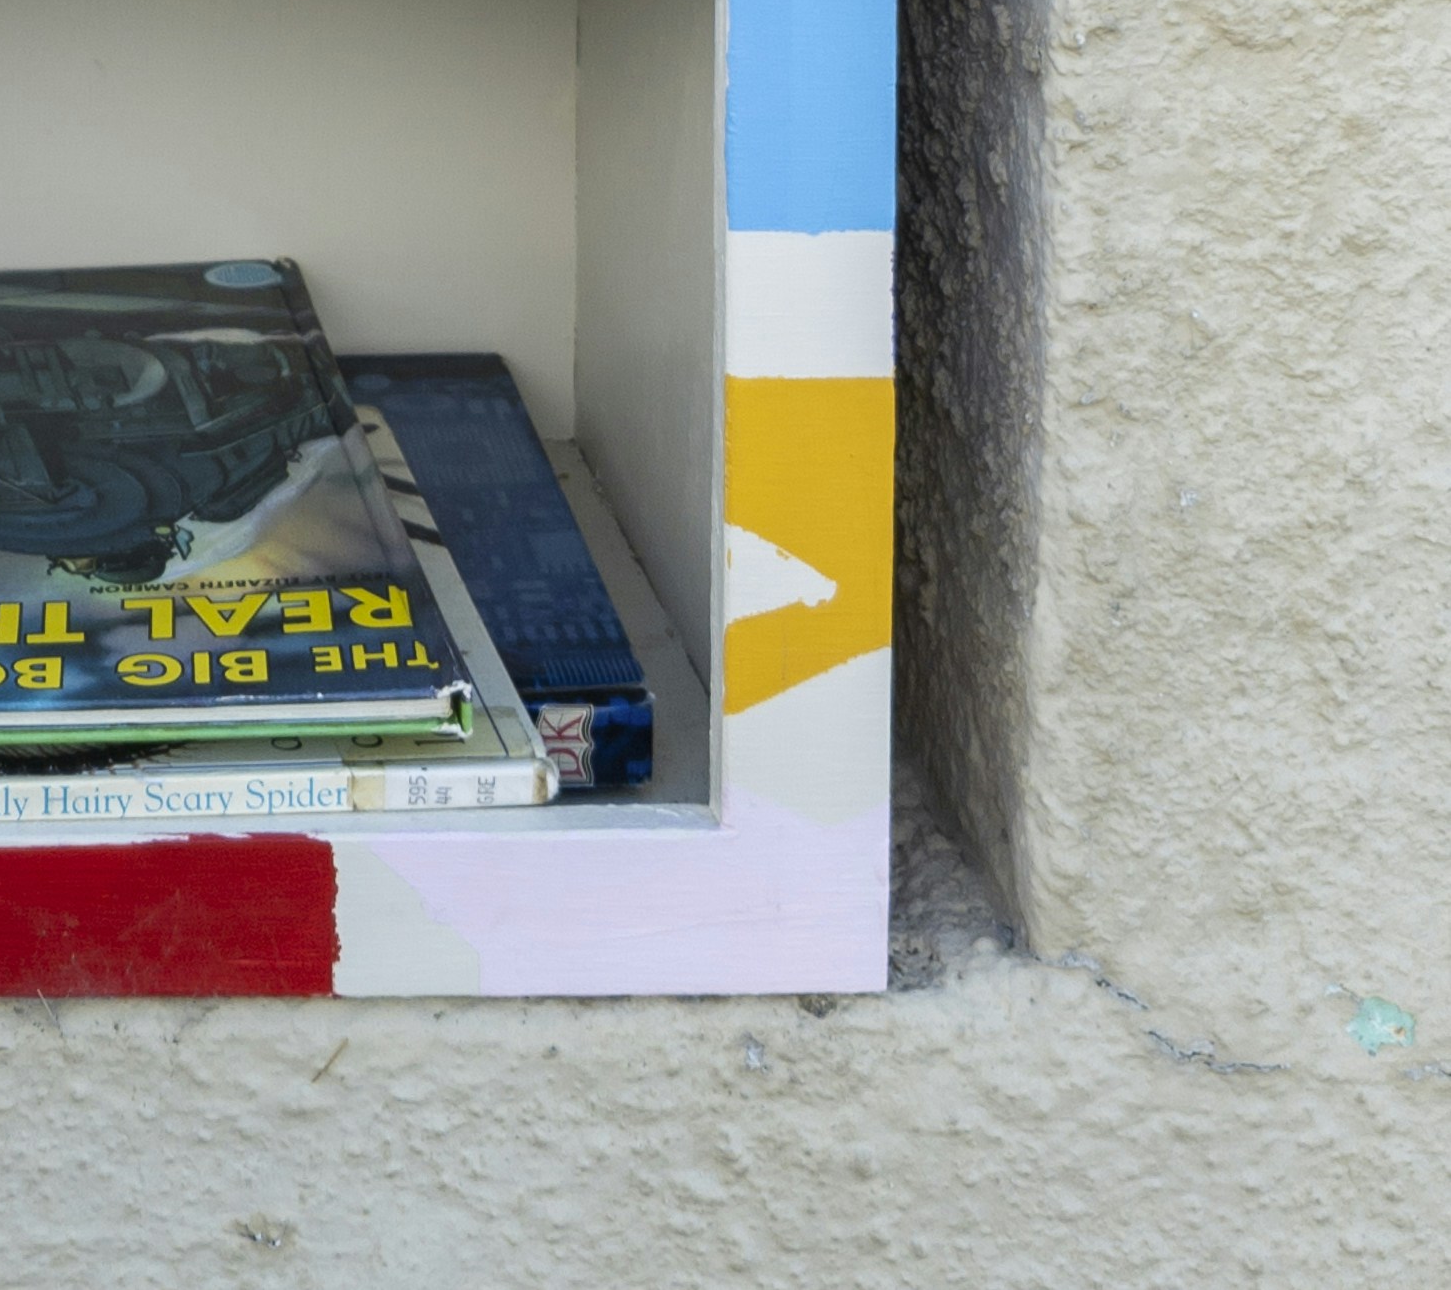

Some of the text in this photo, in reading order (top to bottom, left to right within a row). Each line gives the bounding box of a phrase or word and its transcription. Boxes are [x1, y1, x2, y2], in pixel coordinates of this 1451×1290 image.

[89, 582, 189, 595] CAMERON
[199, 575, 300, 591] ELIZABETH
[122, 584, 413, 640] REAL
[116, 650, 269, 686] BIG
[312, 640, 441, 673] THE
[544, 711, 584, 777] DK
[42, 784, 134, 818] Hairy
[144, 780, 233, 815] Scary
[245, 777, 348, 815] Spider
